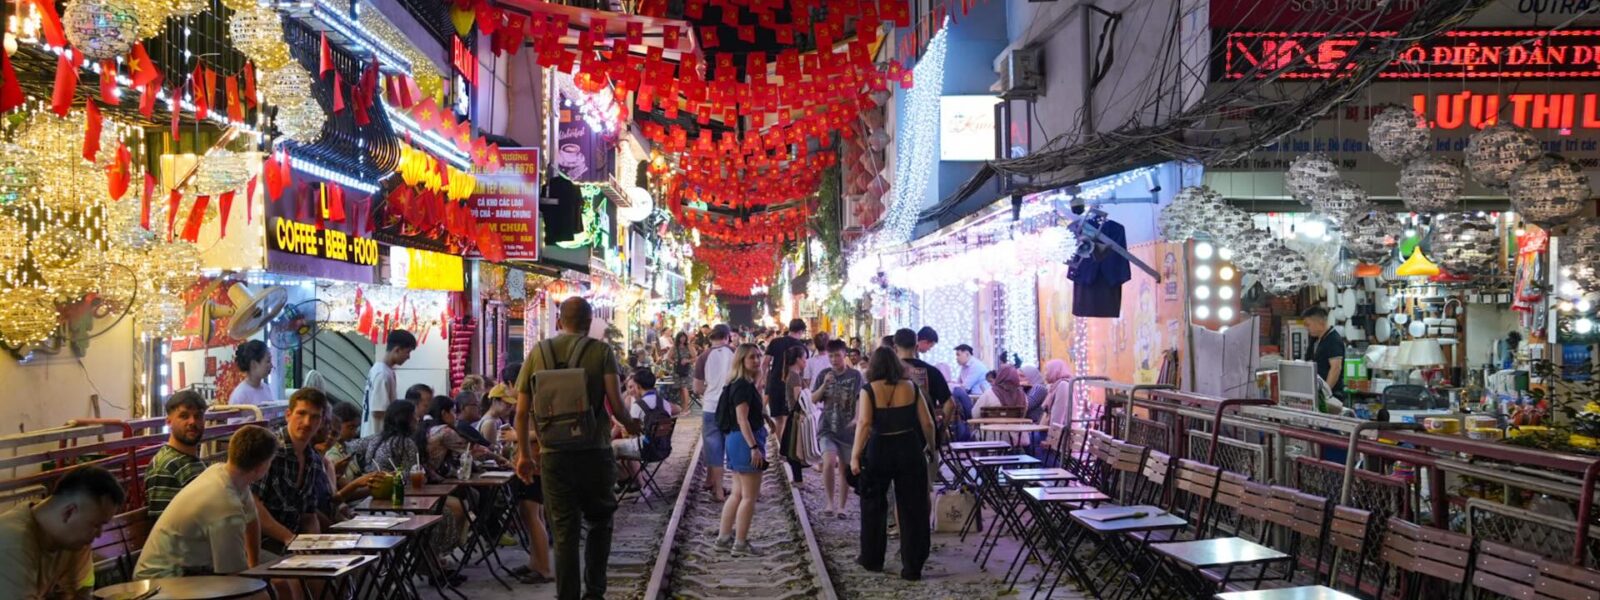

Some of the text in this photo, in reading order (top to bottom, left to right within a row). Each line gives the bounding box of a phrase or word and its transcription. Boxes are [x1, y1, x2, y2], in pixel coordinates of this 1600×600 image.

[277, 216, 318, 256] COFFEE
[325, 228, 348, 261] BEER
[354, 236, 378, 267] FOOD
